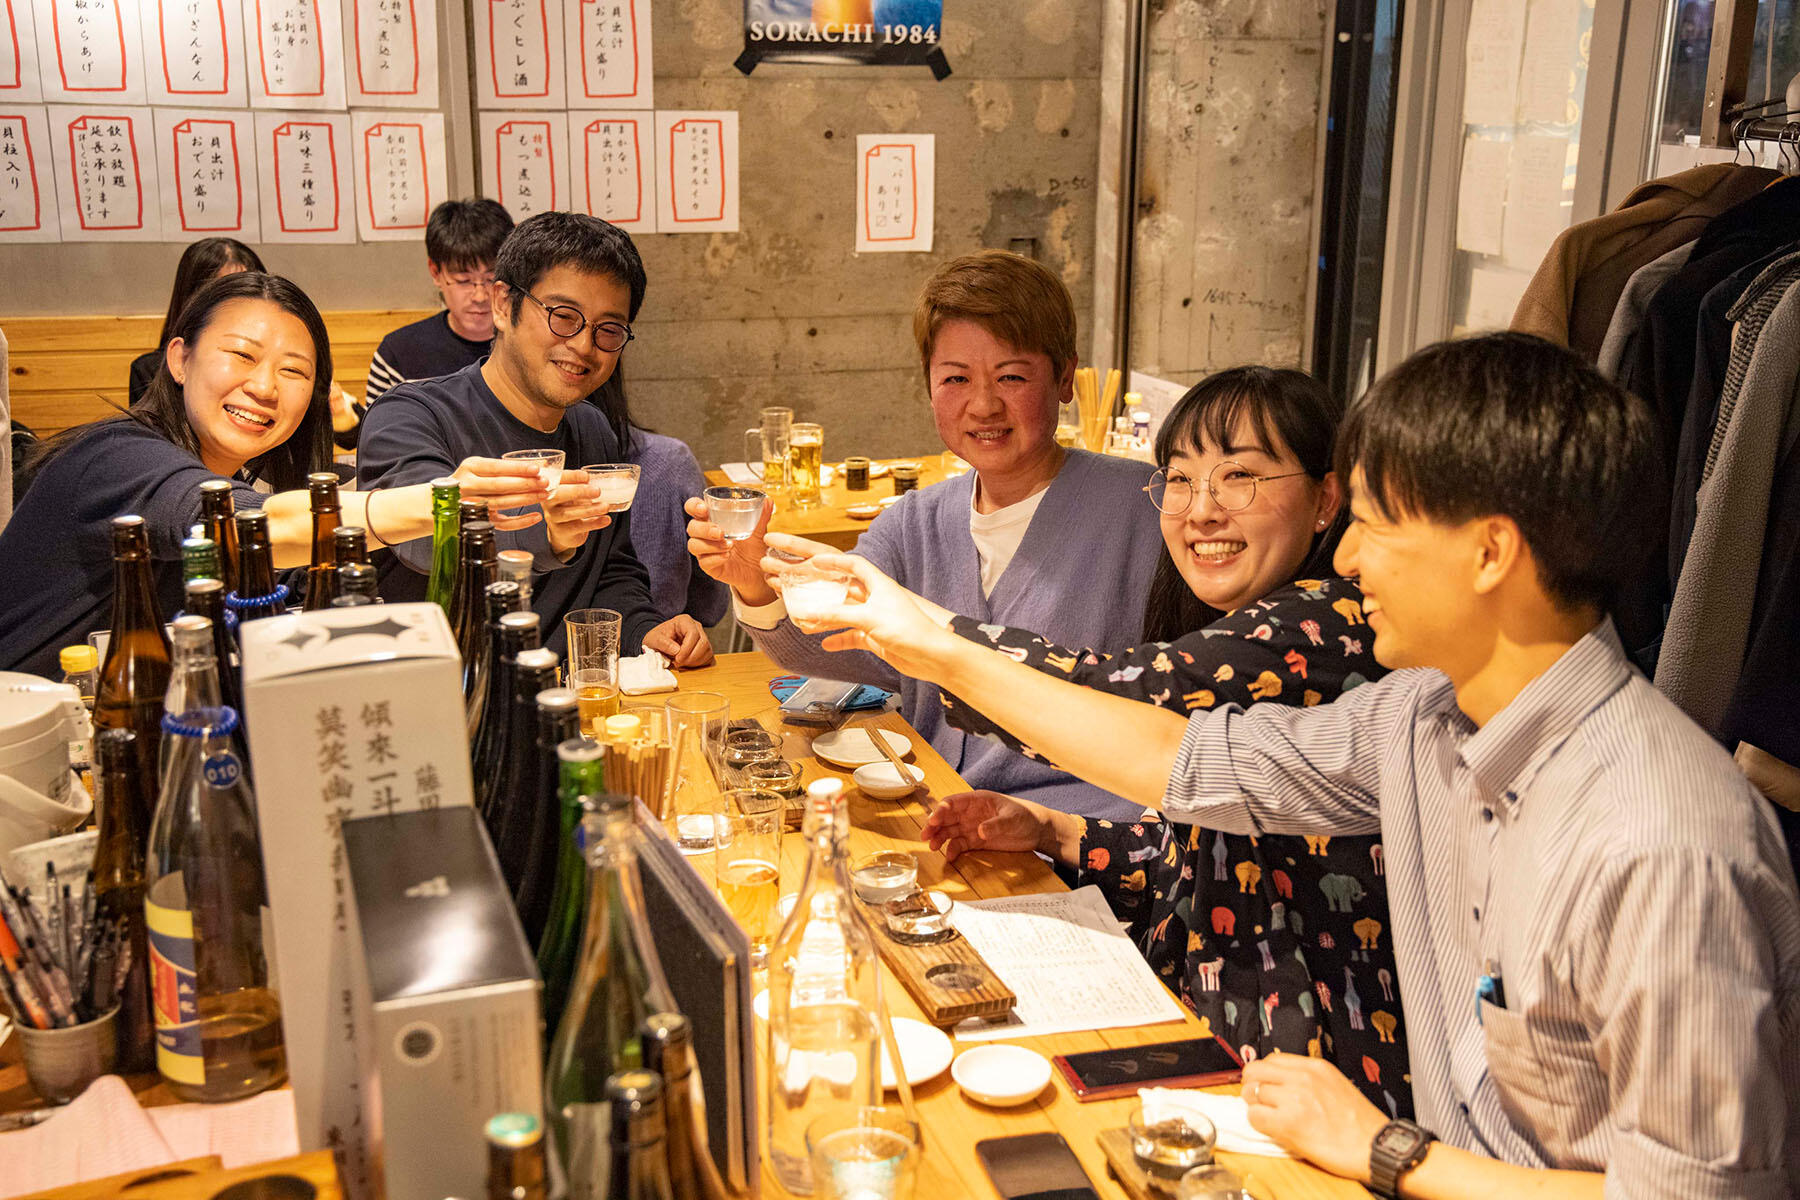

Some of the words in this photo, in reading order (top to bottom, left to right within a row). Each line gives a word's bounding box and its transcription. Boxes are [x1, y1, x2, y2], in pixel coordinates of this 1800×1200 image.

[595, 6, 609, 81] おでん盛り
[749, 20, 874, 45] SORACHI
[882, 23, 939, 46] 1984
[90, 125, 111, 220] 延長承ります
[106, 125, 128, 189] 飲み放題
[191, 136, 208, 213] おでん盛り
[210, 136, 225, 182] 貝出汁
[298, 129, 316, 222] 珍味三種盛り
[517, 134, 532, 212] もつ煮込み
[531, 133, 544, 158] 特製
[602, 124, 615, 215] 貝出汁ラーメン
[206, 763, 238, 783] 010
